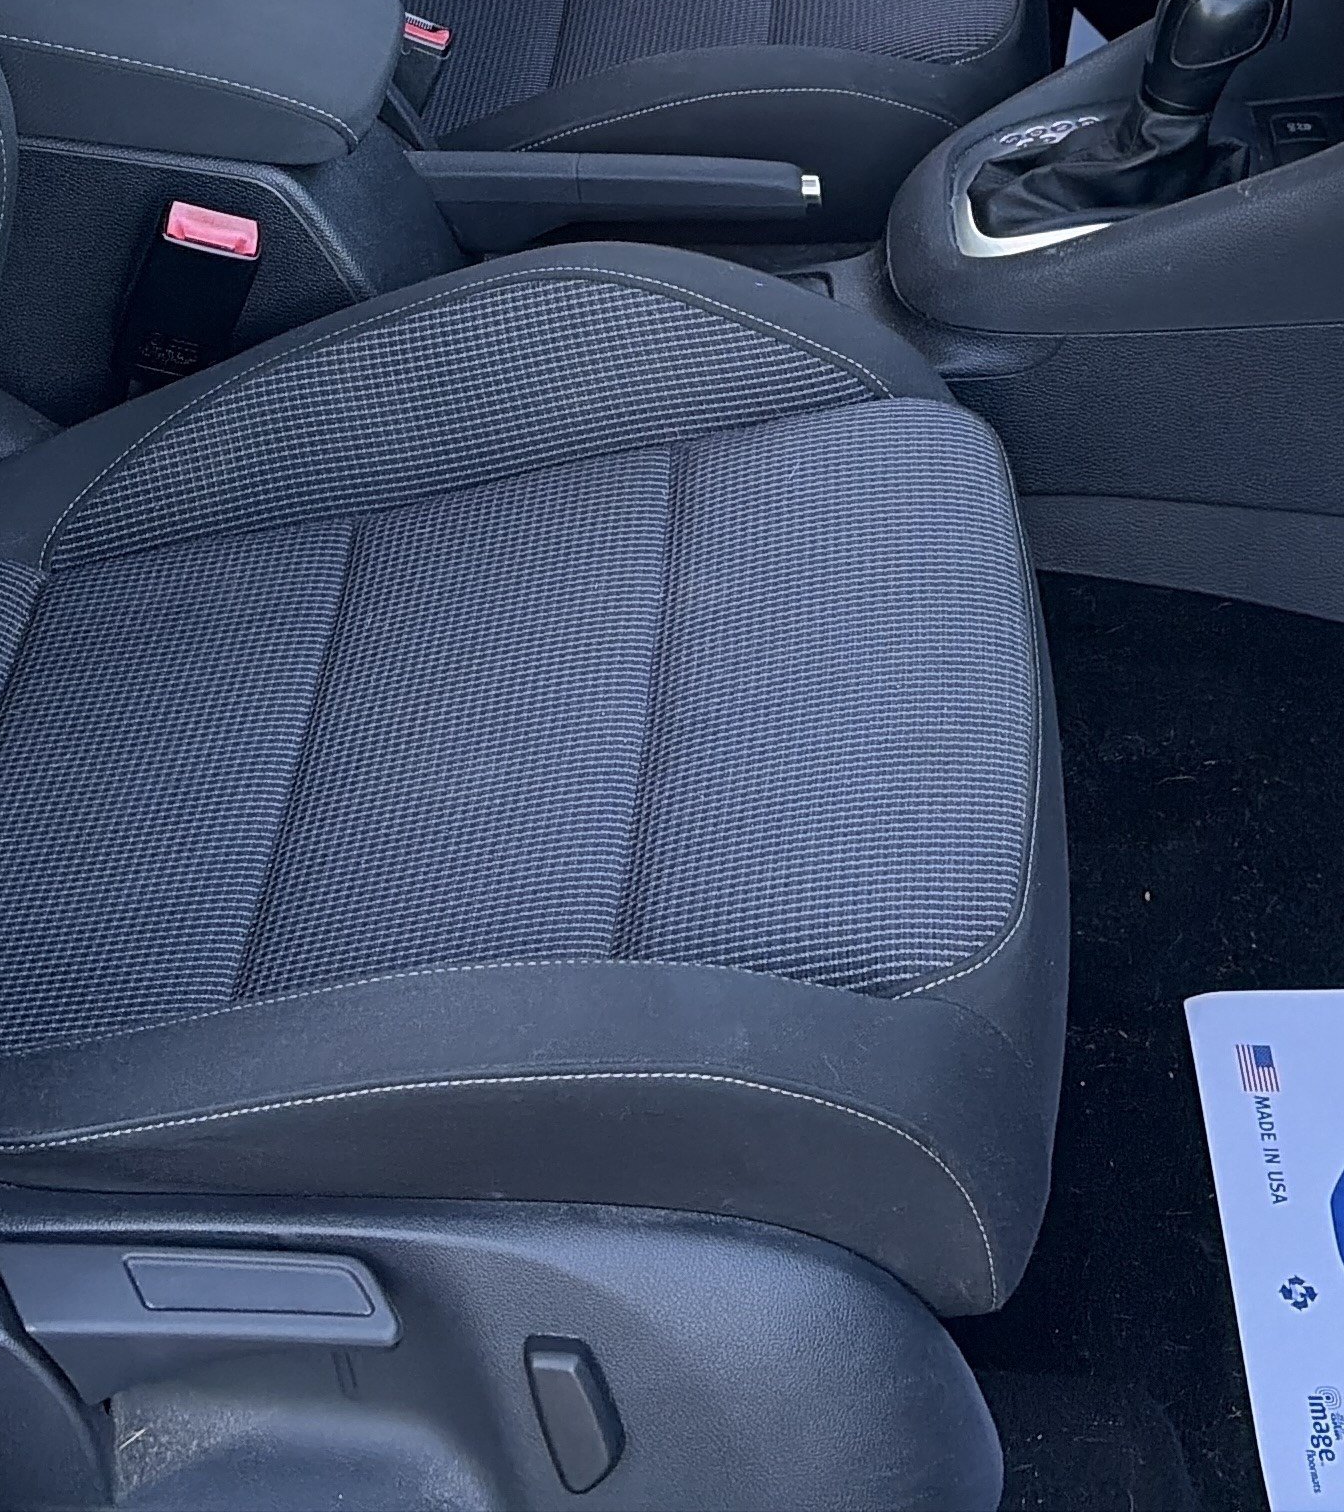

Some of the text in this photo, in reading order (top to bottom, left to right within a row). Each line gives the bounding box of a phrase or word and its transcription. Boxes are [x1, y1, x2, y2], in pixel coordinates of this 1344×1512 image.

[1253, 1095, 1288, 1205] MADE IN USA
[1307, 1395, 1336, 1462] image
[1305, 1449, 1322, 1494] floormats
